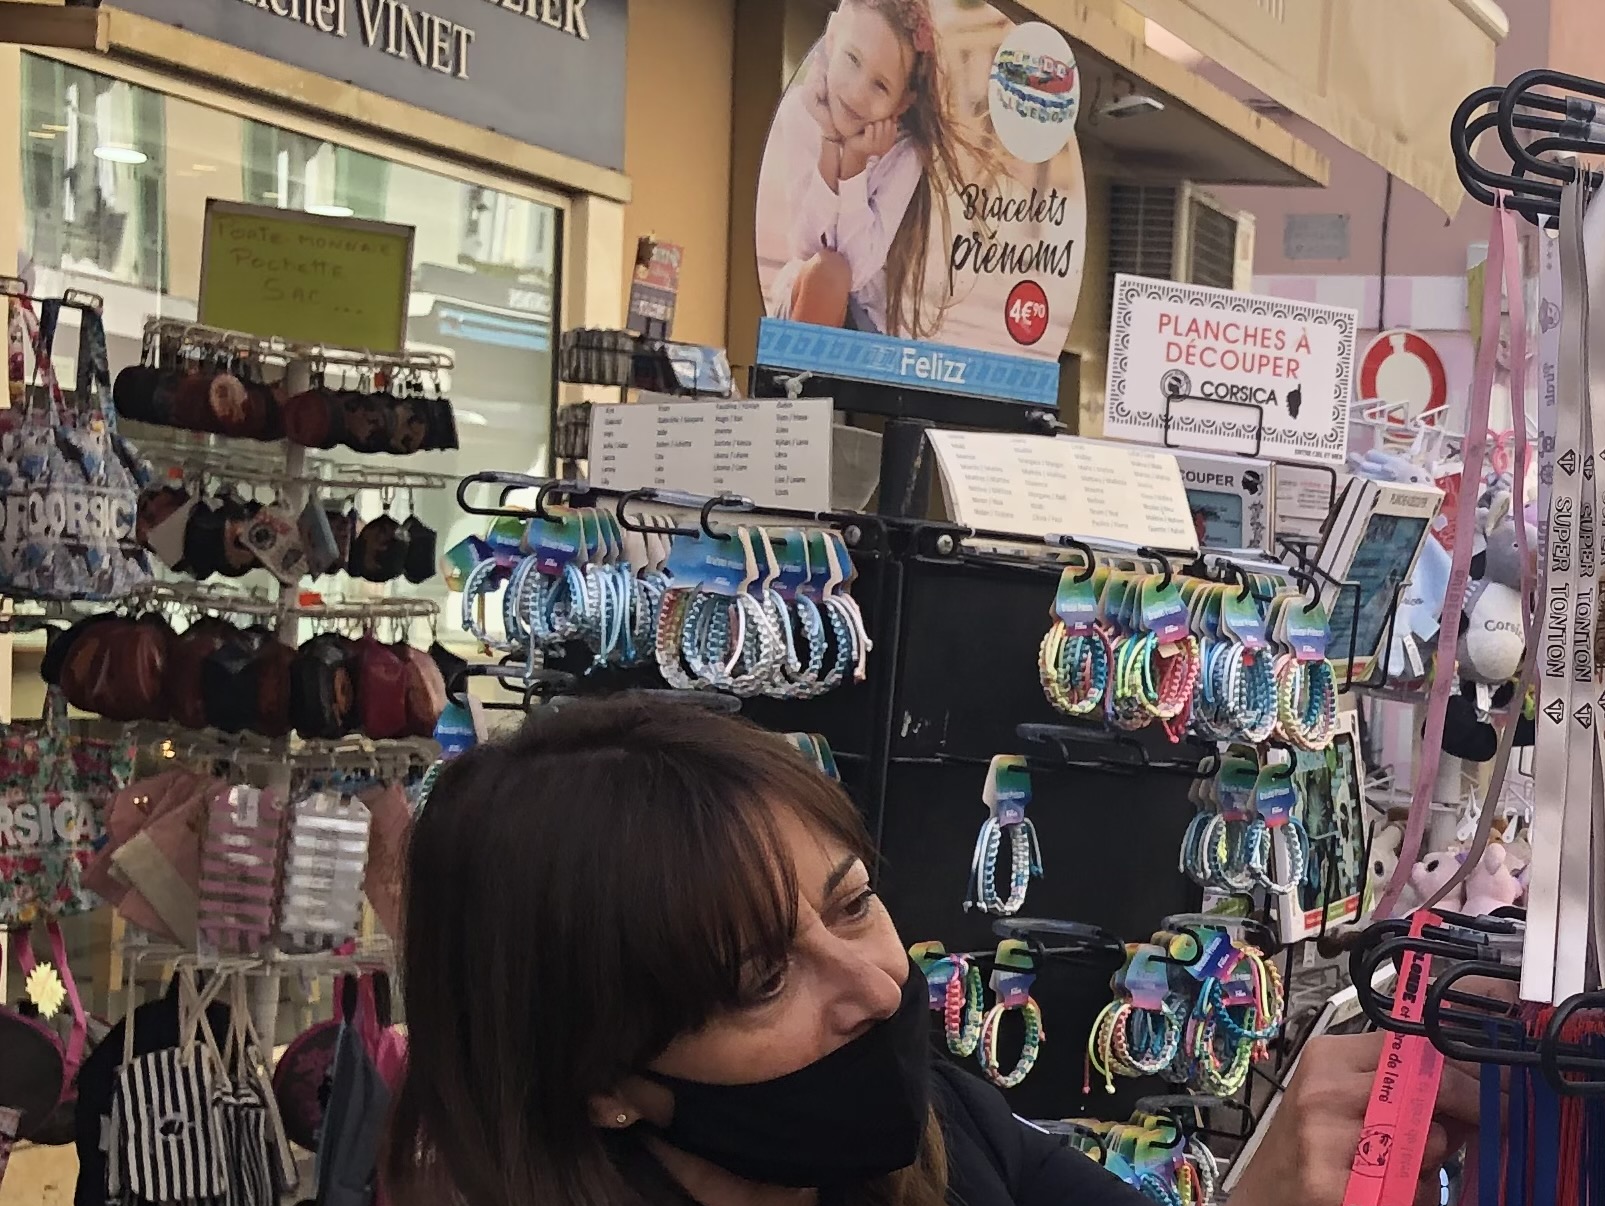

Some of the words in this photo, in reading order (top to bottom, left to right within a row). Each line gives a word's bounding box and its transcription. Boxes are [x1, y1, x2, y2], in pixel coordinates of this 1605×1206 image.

[356, 0, 476, 80] VINET
[960, 183, 1068, 226] Bracelets
[950, 232, 1074, 297] prénoms
[1158, 313, 1286, 351] PLANCHES
[1295, 327, 1311, 354] À
[1165, 339, 1300, 379] DÉCOUPER
[900, 348, 968, 384] Felizz
[1200, 381, 1278, 407] CORSICA
[1552, 496, 1572, 573] SUPER
[1579, 503, 1595, 578] SUPER
[1546, 582, 1569, 679] TONTON
[1574, 591, 1595, 683] TONTON
[1402, 953, 1425, 1004] LONDE
